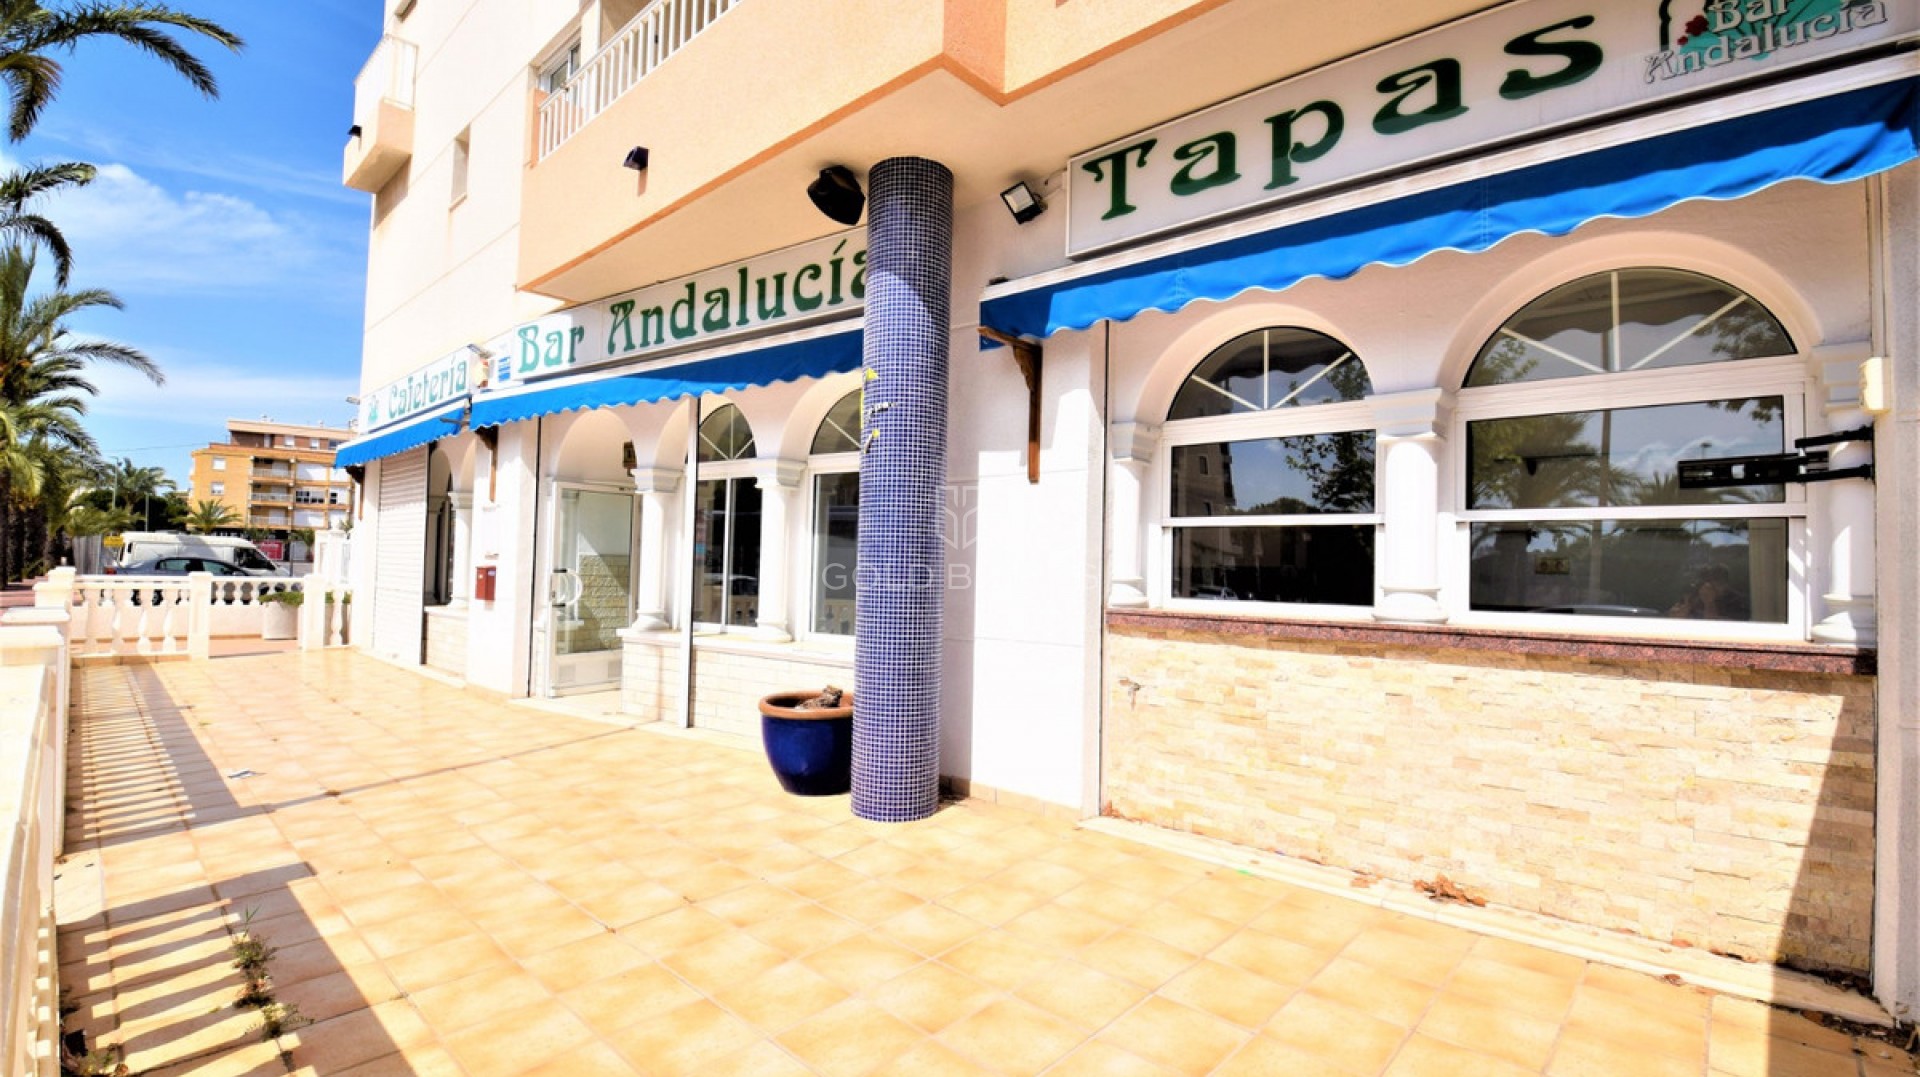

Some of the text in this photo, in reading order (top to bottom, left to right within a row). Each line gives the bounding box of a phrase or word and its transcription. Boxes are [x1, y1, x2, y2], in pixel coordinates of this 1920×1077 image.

[1708, 0, 1787, 33] Bar
[1081, 14, 1604, 222] Tapas
[517, 323, 585, 374] Bar
[387, 352, 468, 420] Cafetería
